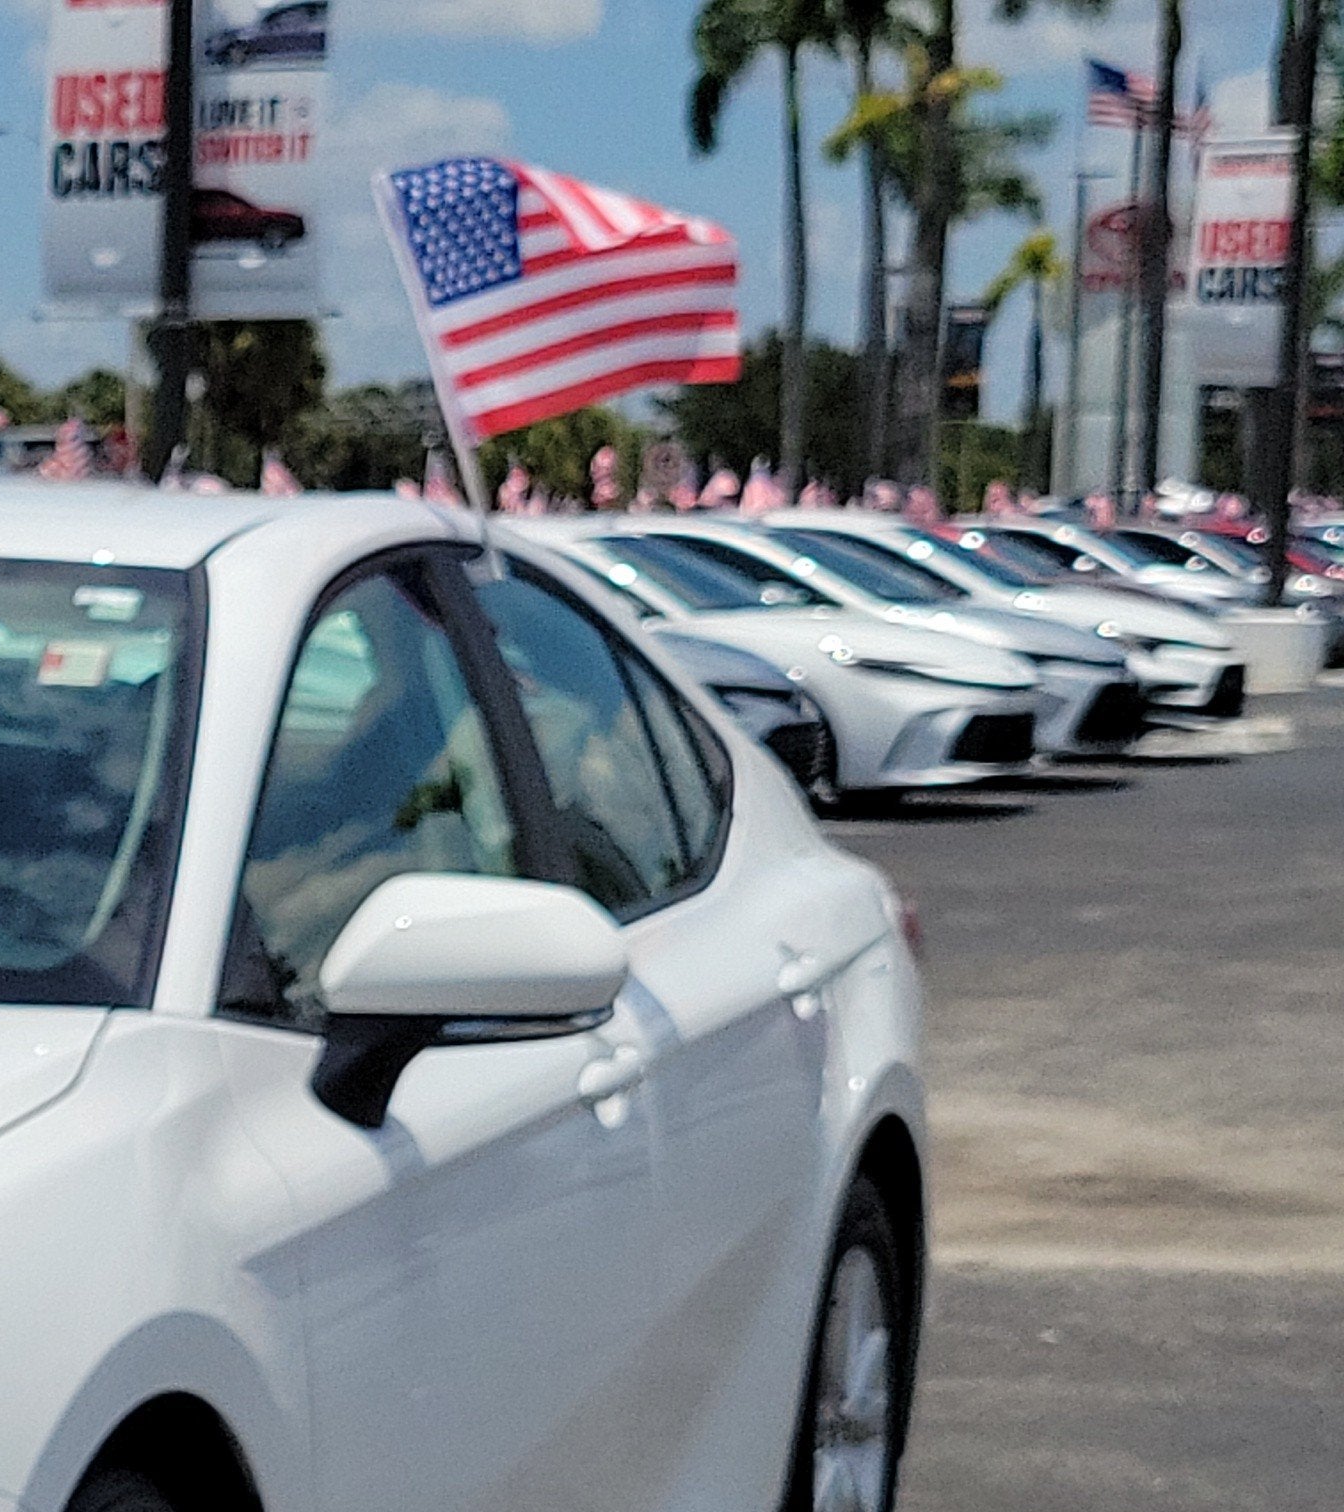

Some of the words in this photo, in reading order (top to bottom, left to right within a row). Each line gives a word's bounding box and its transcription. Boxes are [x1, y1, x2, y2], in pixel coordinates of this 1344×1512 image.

[55, 71, 168, 134] USED
[53, 140, 169, 197] CARS
[1201, 220, 1292, 262] USED
[1198, 267, 1286, 304] CARS
